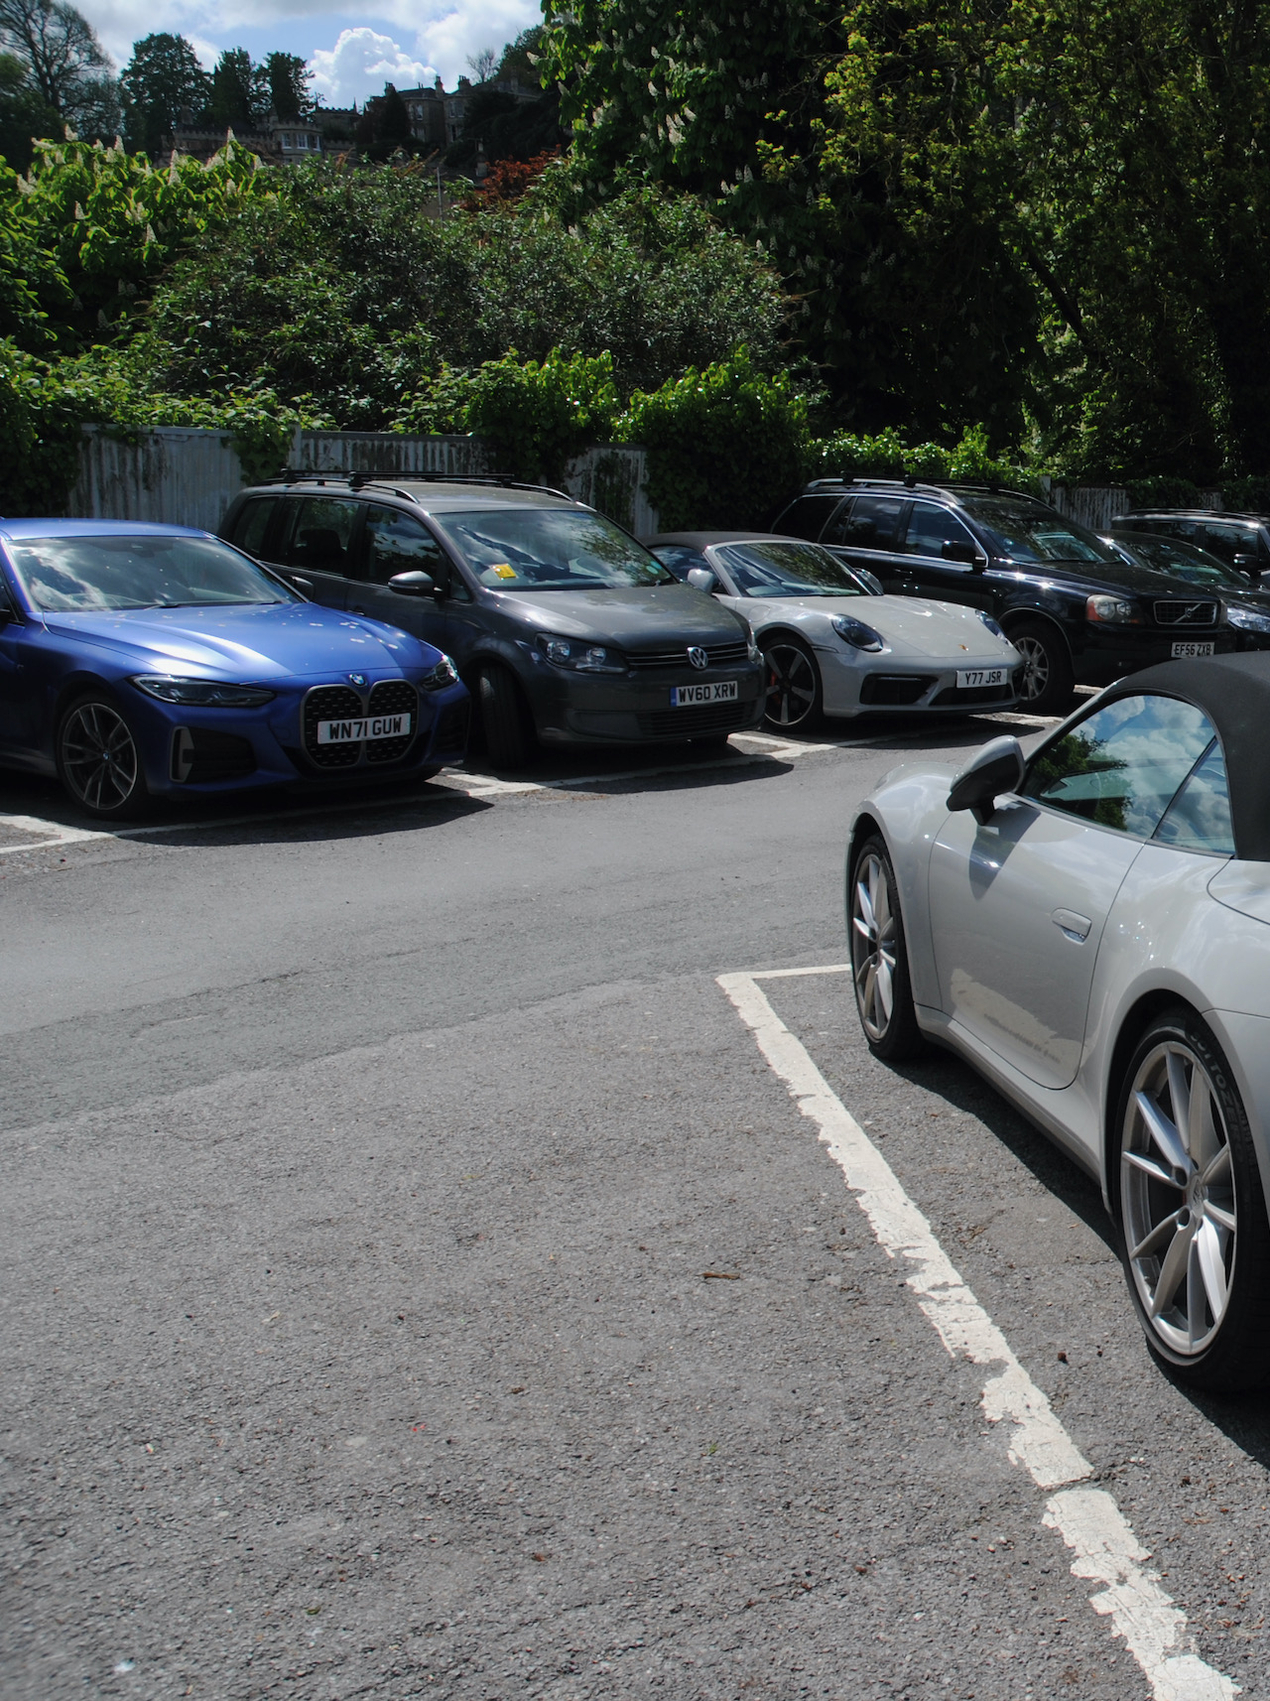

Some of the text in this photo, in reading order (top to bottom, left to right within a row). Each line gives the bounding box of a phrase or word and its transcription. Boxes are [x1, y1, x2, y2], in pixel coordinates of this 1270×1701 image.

[1174, 644, 1196, 656] EF56
[965, 670, 1002, 685] Y77 JSR
[679, 683, 736, 703] WV60 XRW
[330, 717, 402, 739] WN71 GUW
